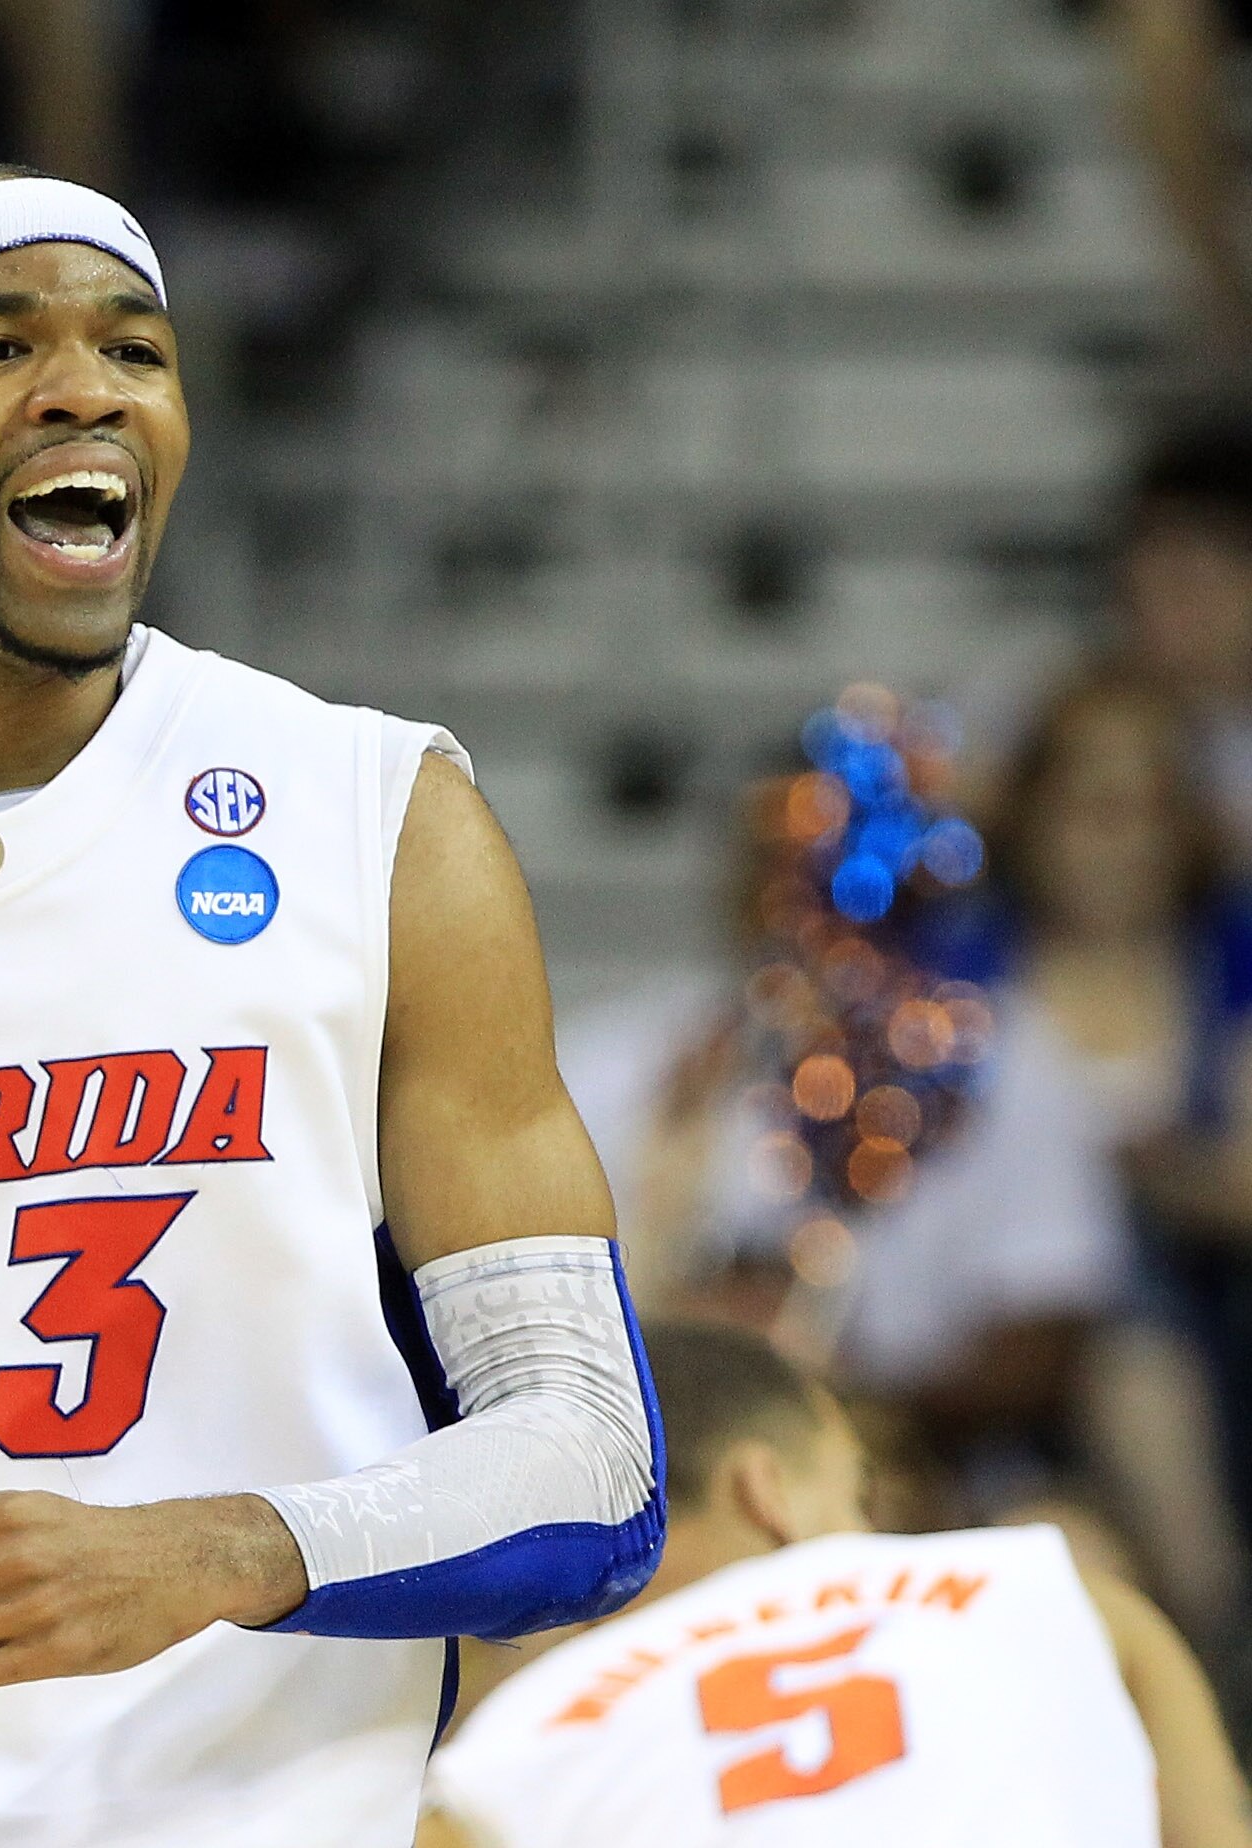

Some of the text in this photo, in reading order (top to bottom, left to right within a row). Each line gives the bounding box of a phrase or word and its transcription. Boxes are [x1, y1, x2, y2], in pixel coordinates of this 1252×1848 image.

[191, 771, 260, 831] SEC
[191, 892, 265, 915] NCAA
[698, 1624, 906, 1815] 5
